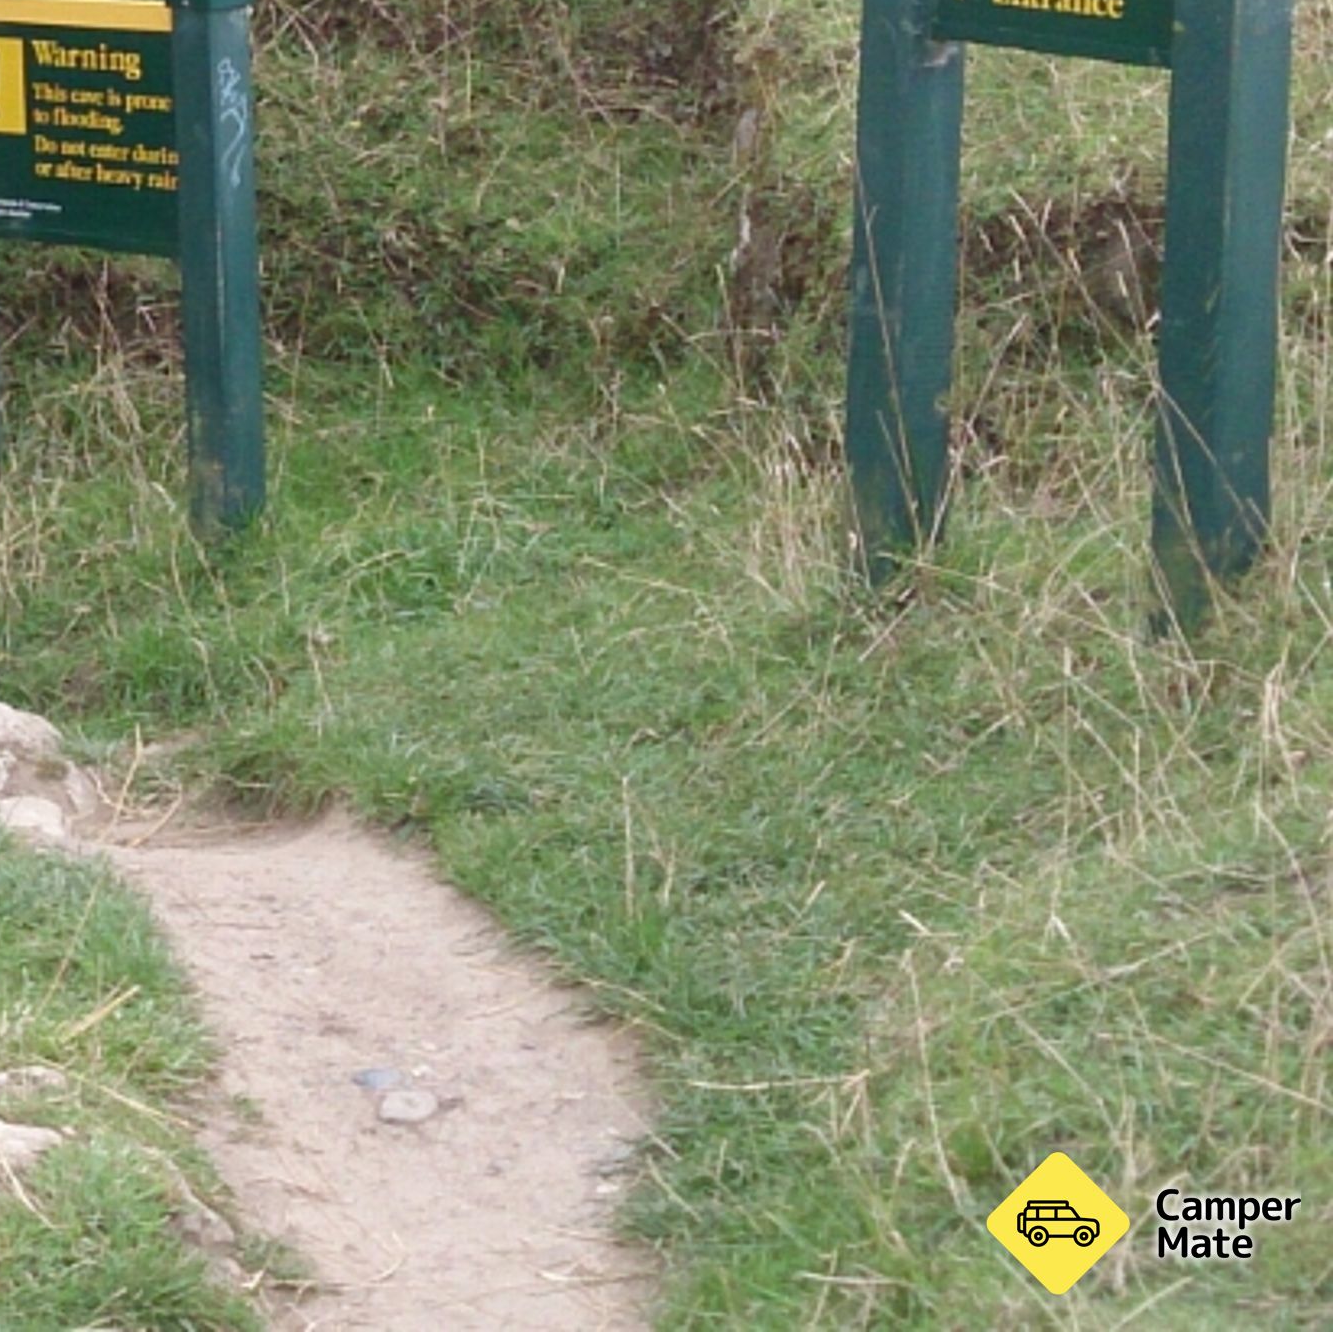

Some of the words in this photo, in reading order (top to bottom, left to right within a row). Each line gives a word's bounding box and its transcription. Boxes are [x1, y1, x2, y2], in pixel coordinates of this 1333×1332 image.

[31, 39, 142, 81] Warning
[33, 81, 67, 103] This
[70, 90, 105, 106] cave
[106, 87, 121, 106] is
[125, 94, 173, 114] prone
[34, 108, 49, 125] to
[34, 134, 58, 153] Do
[60, 141, 85, 156] not
[89, 144, 131, 161] enter
[133, 144, 179, 165] durin
[35, 162, 53, 177] or
[54, 160, 94, 181] after
[97, 163, 142, 191] heavy
